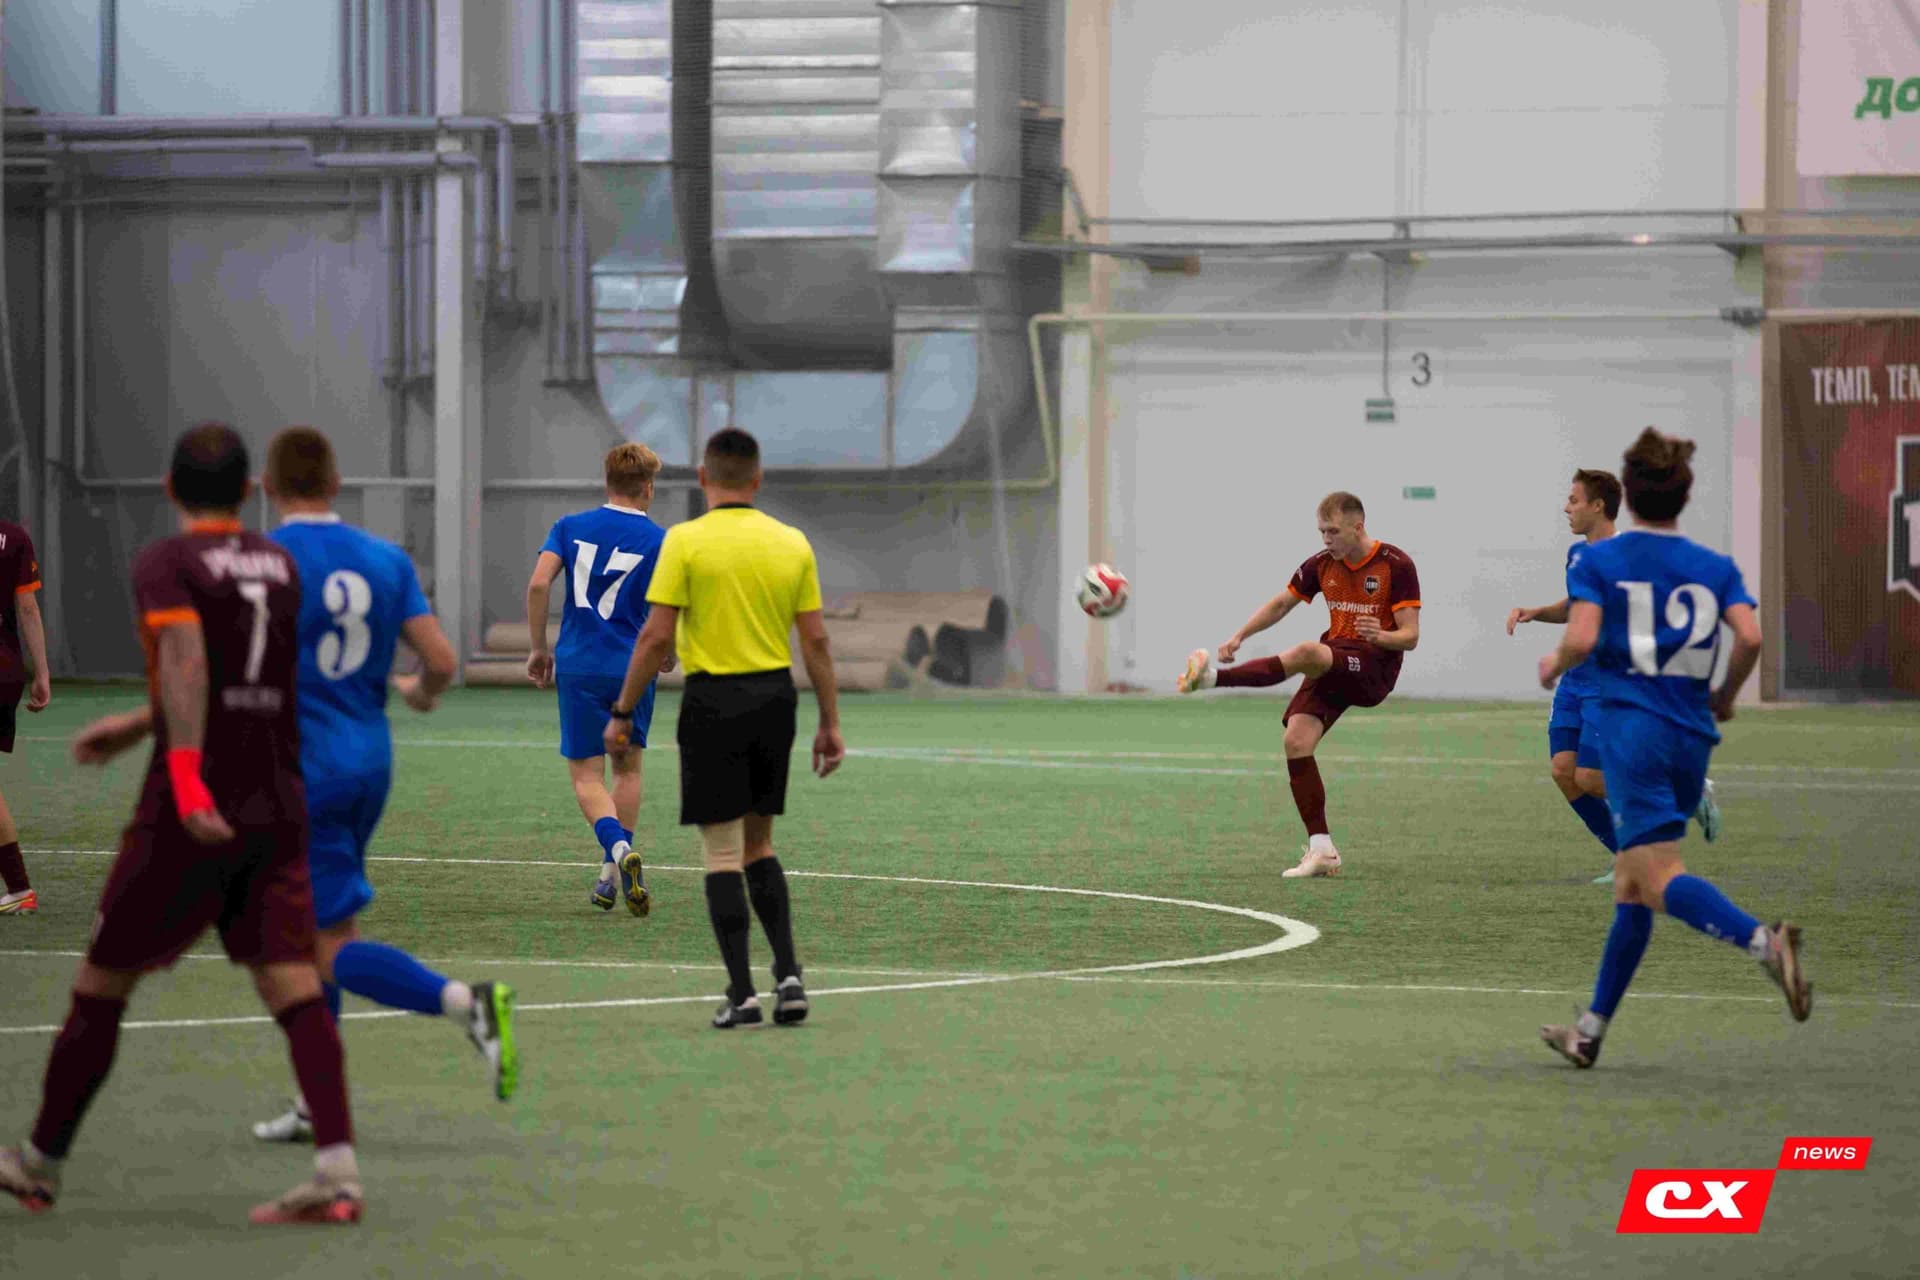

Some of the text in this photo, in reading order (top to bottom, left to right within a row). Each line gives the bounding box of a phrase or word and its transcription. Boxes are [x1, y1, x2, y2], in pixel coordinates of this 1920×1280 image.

[1411, 352, 1431, 386] 3
[1809, 366, 1878, 407] ТЕМП,
[316, 569, 371, 680] 3
[573, 539, 644, 620] 17
[237, 581, 270, 683] 7
[1616, 580, 1719, 680] 12
